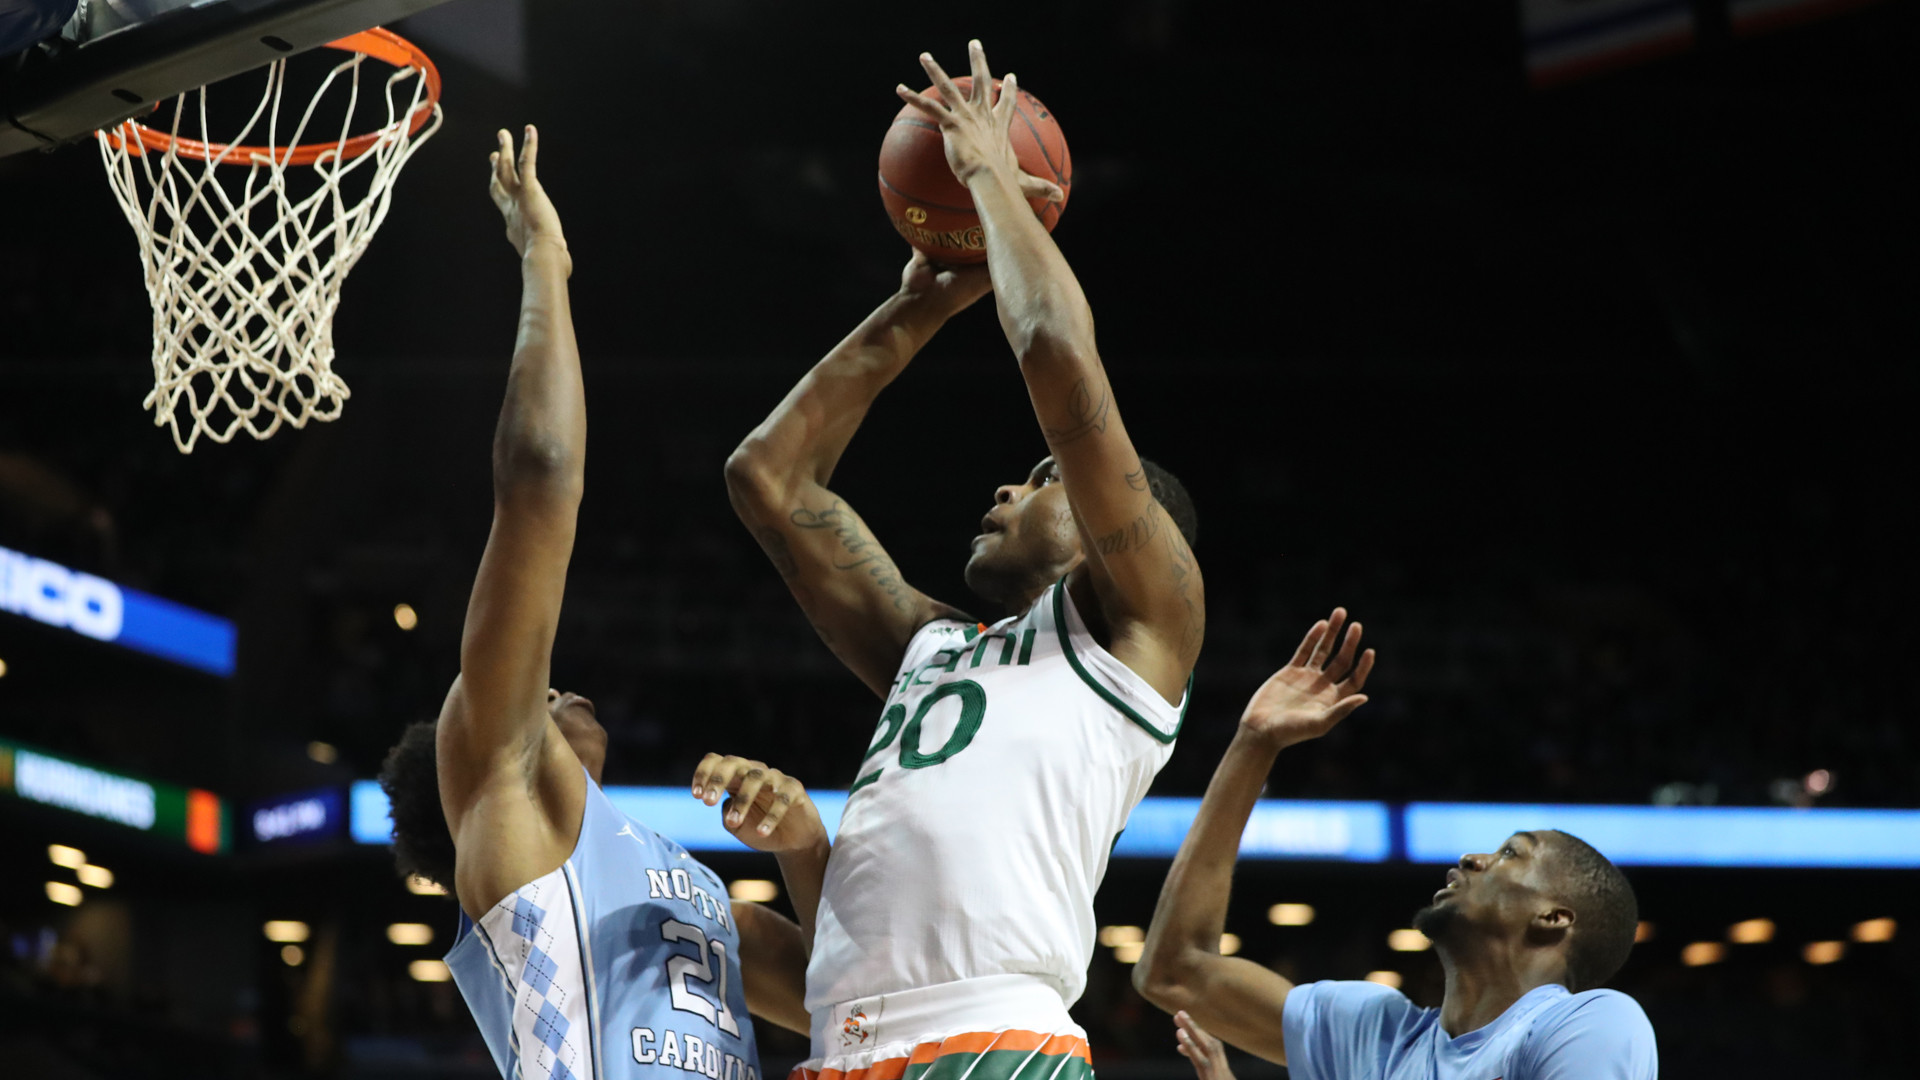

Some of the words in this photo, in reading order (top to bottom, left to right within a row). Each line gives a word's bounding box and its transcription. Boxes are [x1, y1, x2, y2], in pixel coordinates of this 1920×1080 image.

[0, 545, 124, 642] ICO
[848, 678, 987, 797] 20
[660, 917, 741, 1040] 21
